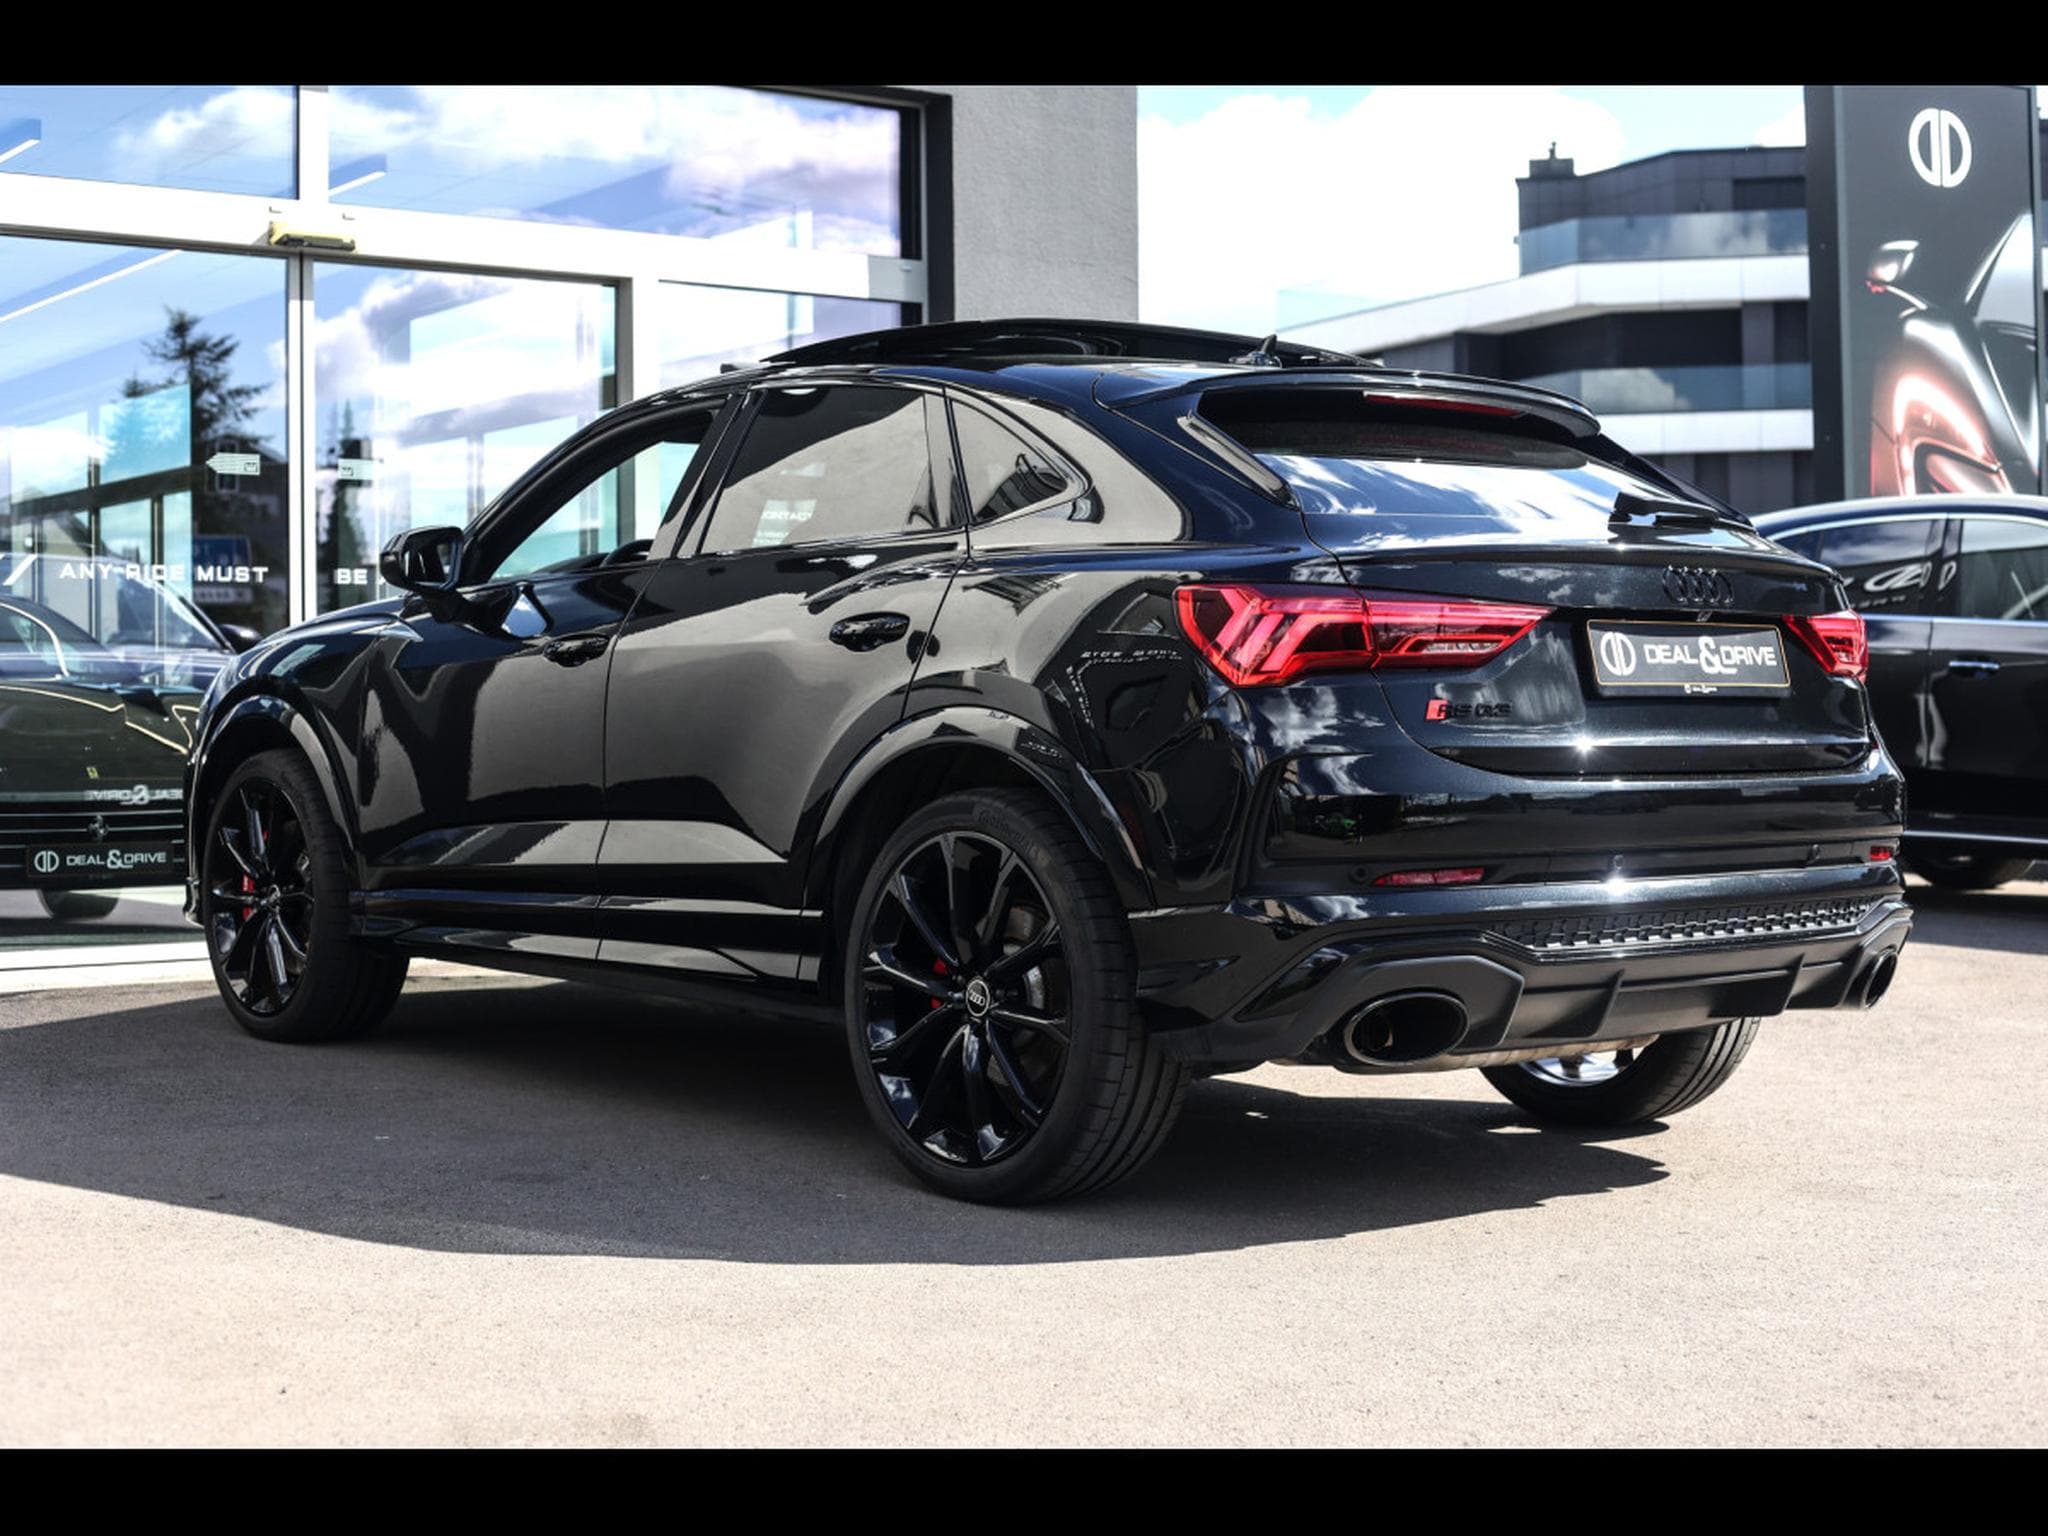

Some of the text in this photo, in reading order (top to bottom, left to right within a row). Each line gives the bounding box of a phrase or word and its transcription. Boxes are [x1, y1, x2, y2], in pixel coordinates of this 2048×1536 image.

[59, 562, 110, 580] ANY
[126, 564, 185, 582] RIDE
[197, 566, 269, 583] MUST
[334, 568, 368, 585] BE
